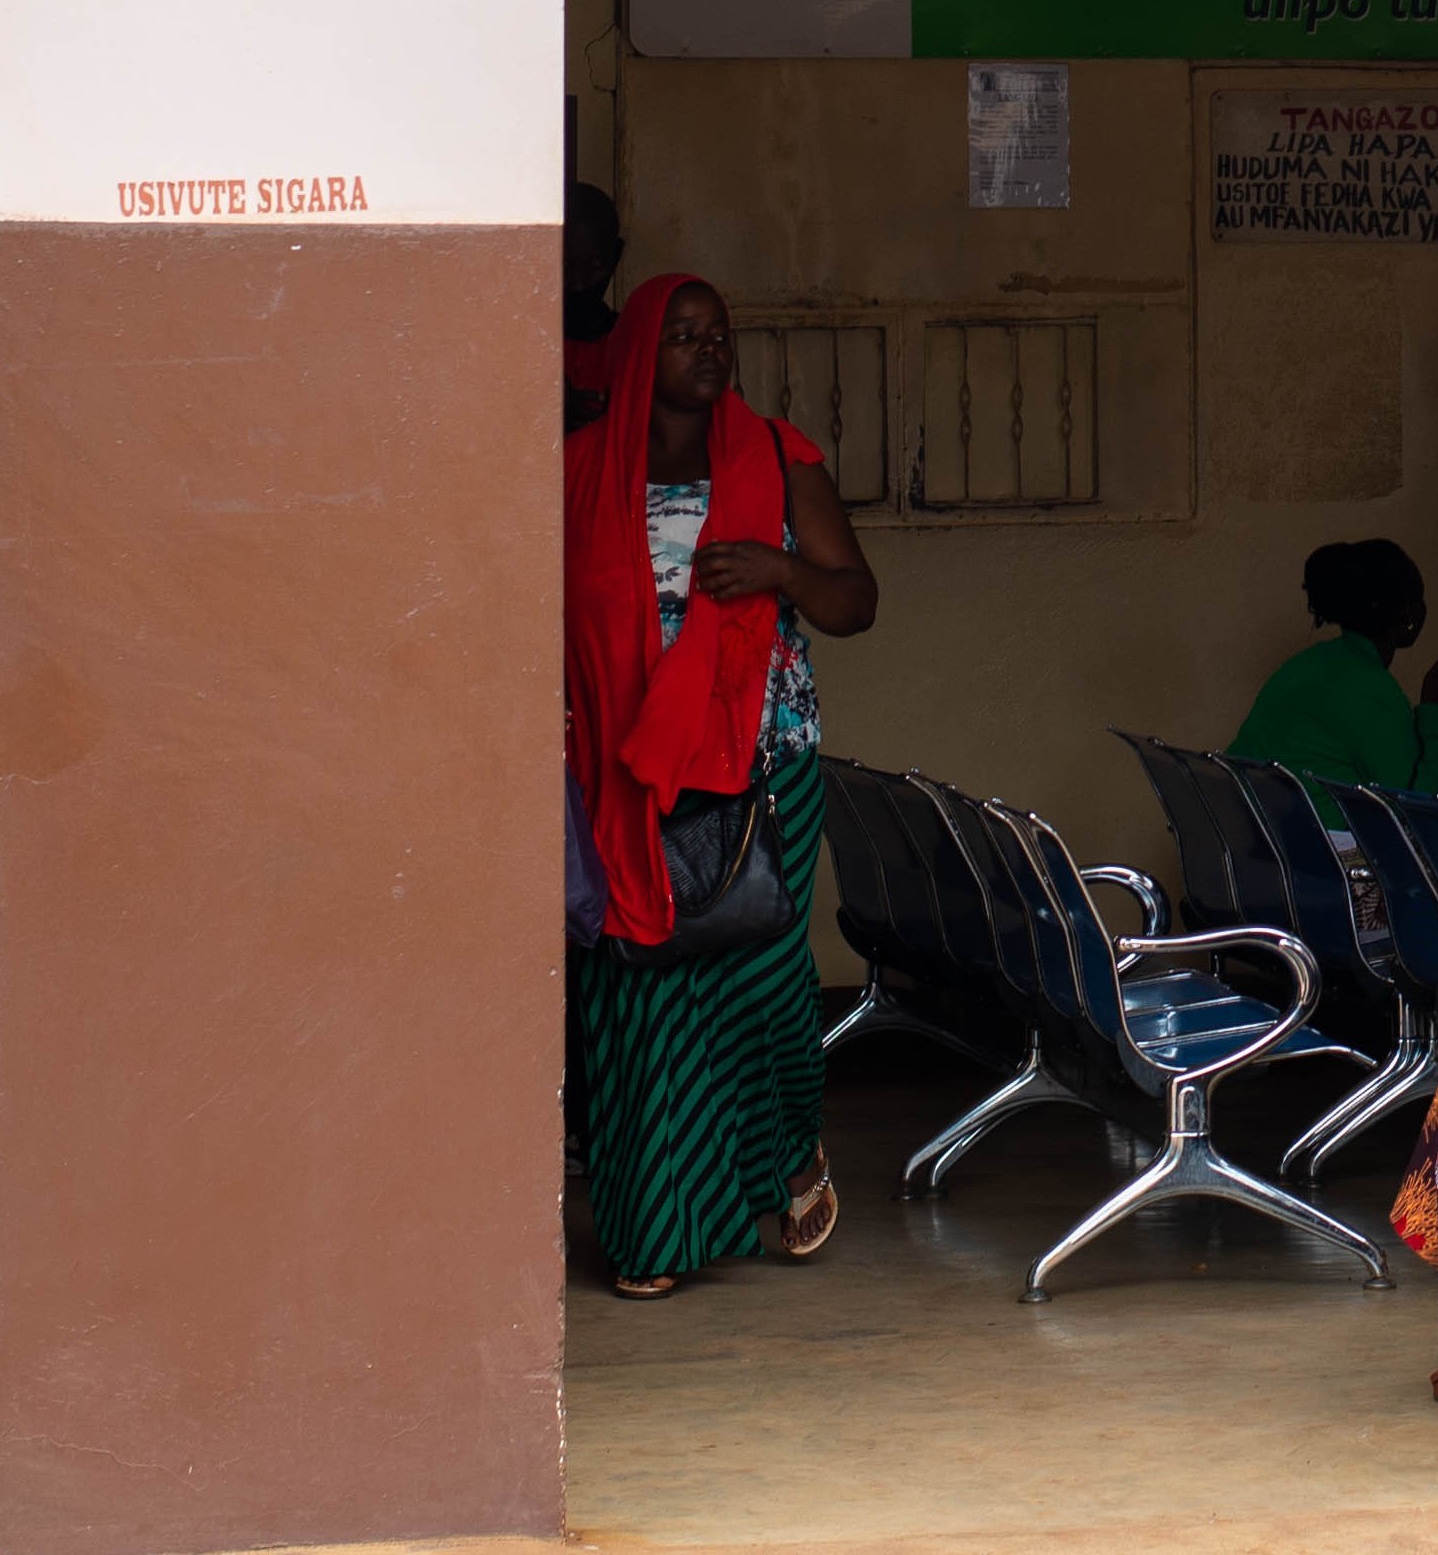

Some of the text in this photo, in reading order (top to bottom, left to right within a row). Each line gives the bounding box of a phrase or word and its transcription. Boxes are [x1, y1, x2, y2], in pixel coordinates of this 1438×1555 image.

[1267, 132, 1437, 160] LIPA HAPA
[1216, 154, 1328, 180] HUDUMA
[1341, 159, 1369, 183] NI
[118, 175, 369, 218] USIVUTE SIGARA
[1216, 182, 1291, 204] USITOE
[1301, 184, 1373, 208] FEDHA
[1382, 186, 1431, 211] KWA
[1215, 207, 1244, 229] AU
[1250, 205, 1411, 239] MFANYAKAZI
